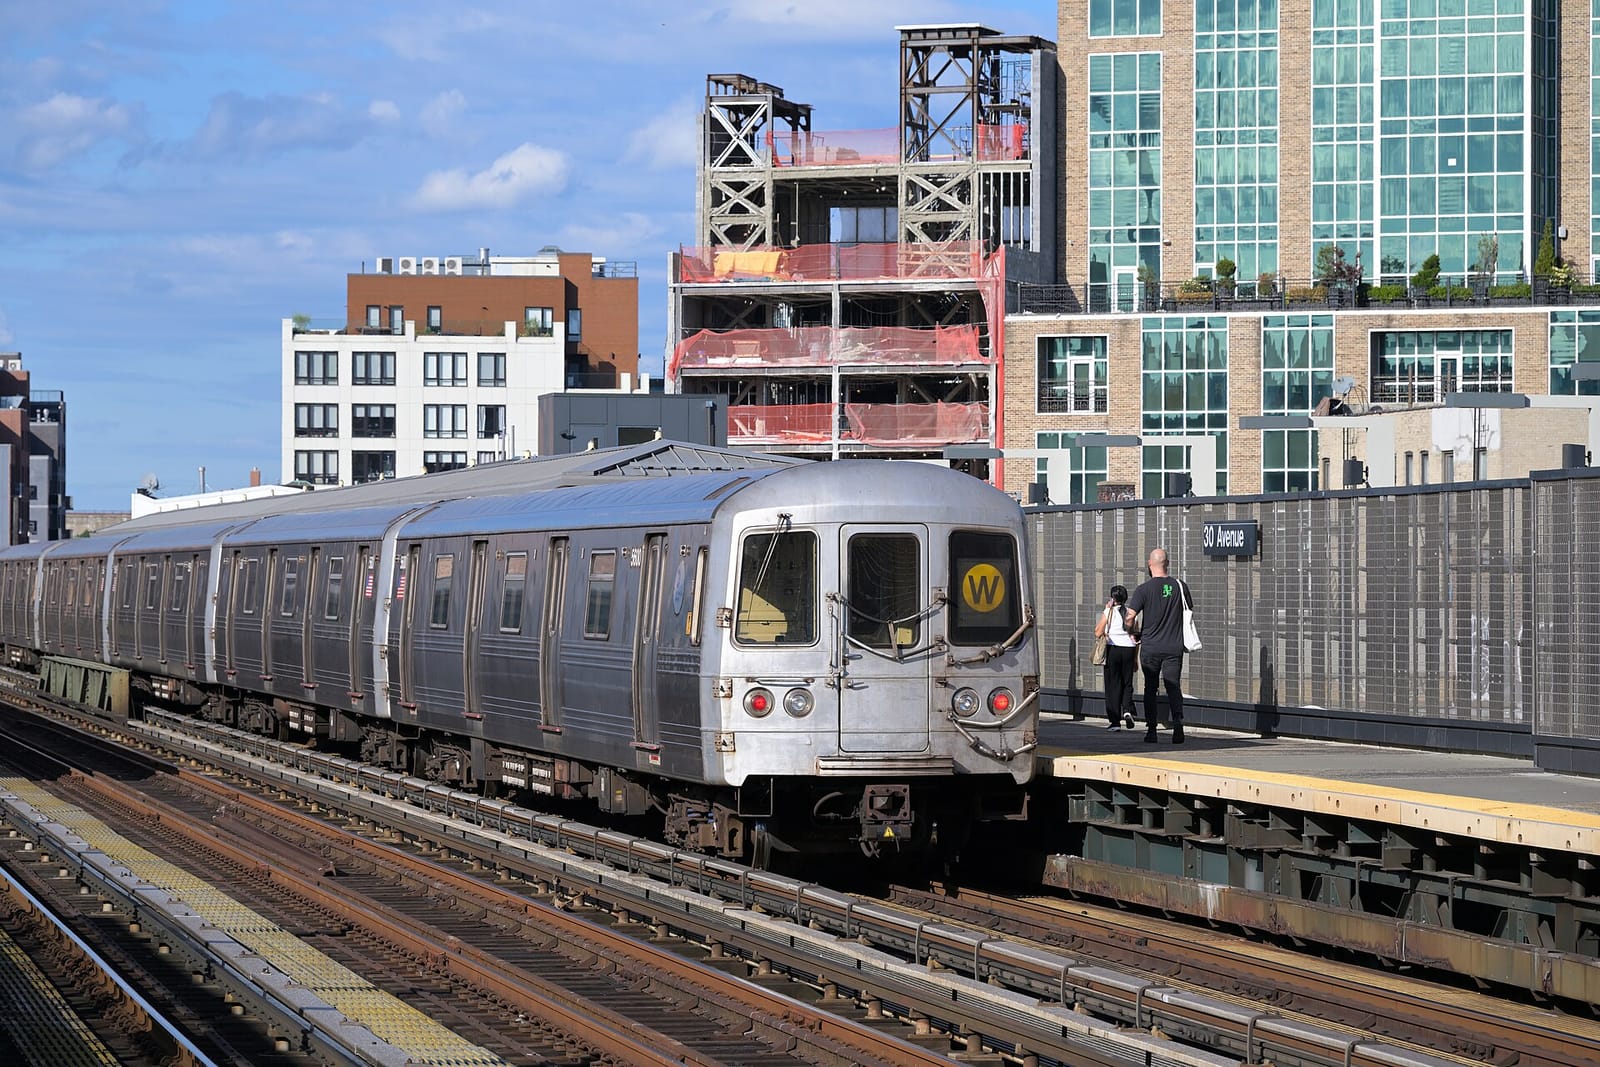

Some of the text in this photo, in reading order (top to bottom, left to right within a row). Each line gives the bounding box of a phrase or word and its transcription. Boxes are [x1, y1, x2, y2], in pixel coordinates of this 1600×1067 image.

[1203, 525, 1245, 548] 30 Avenue
[967, 575, 1001, 605] W
